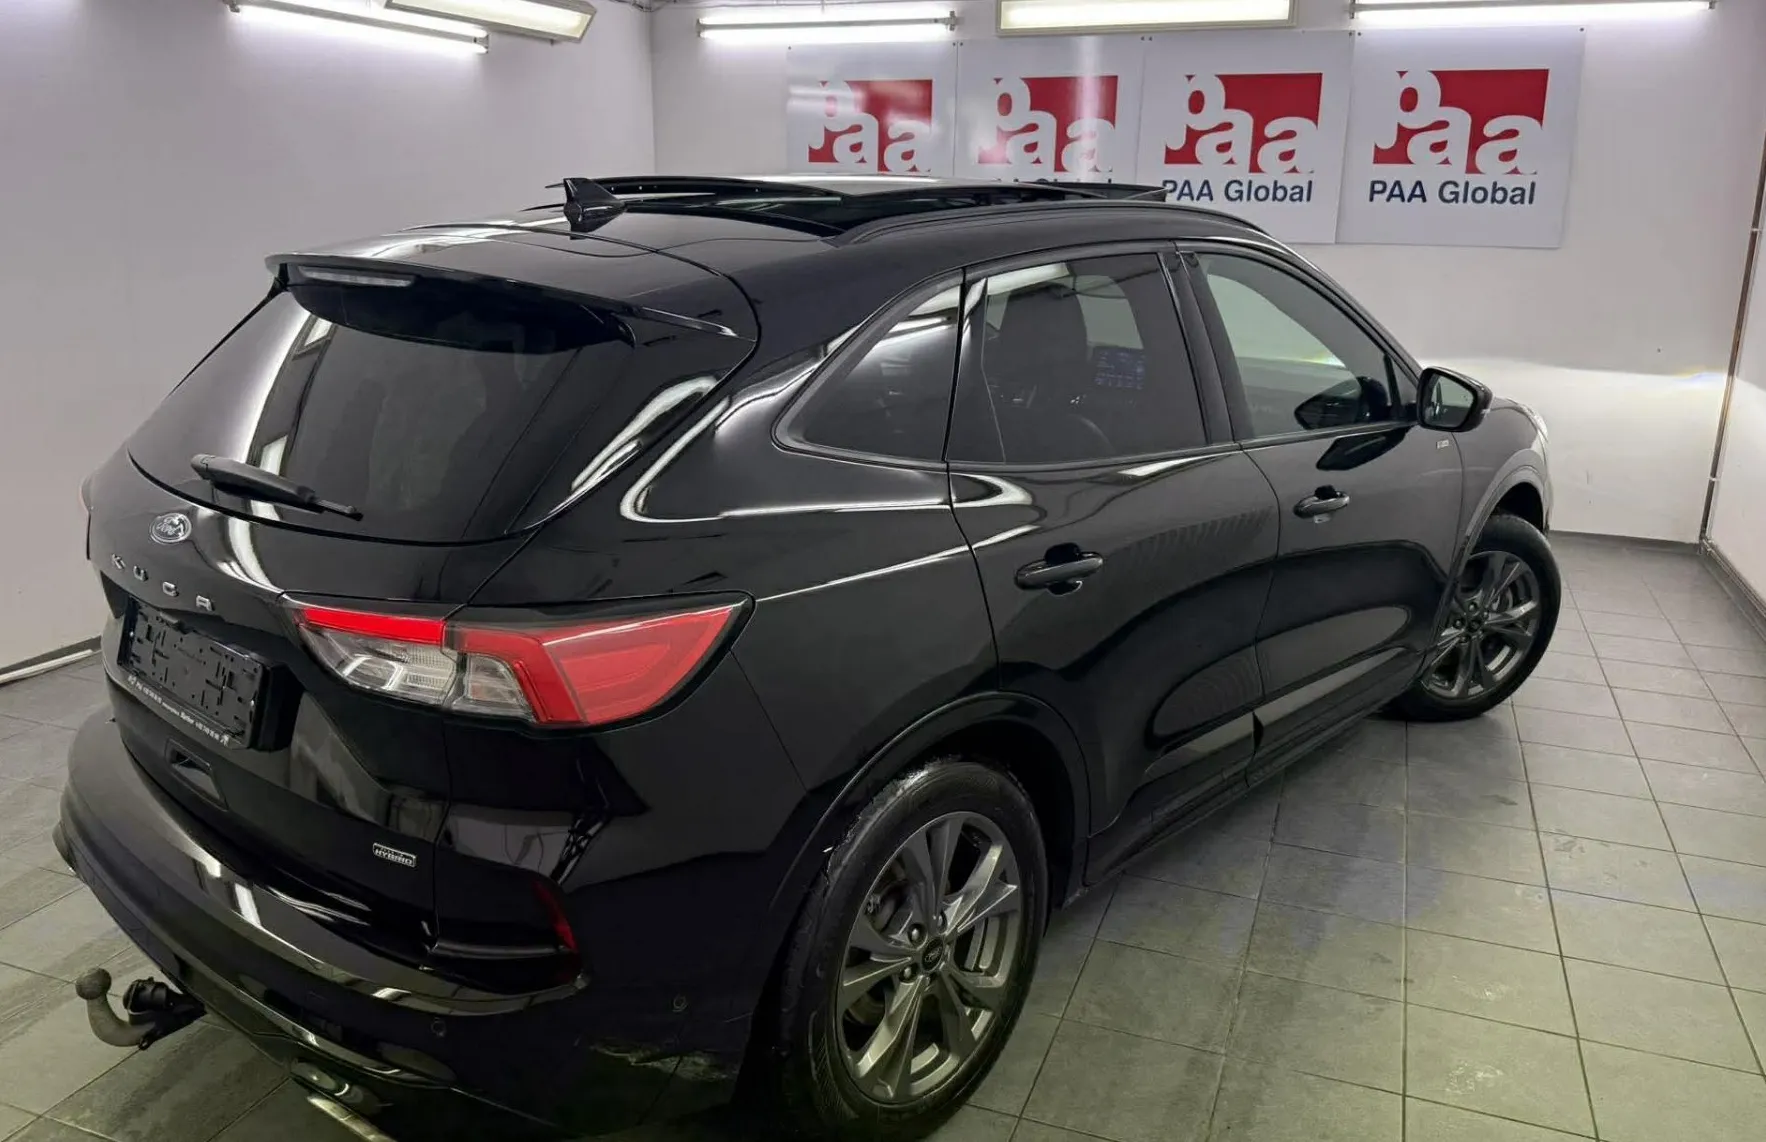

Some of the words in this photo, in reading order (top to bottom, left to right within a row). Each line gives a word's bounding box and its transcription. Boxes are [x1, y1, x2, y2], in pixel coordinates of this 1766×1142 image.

[1165, 73, 1318, 173] paa
[1373, 69, 1544, 175] paa
[1162, 179, 1214, 202] PAA
[1224, 179, 1313, 203] Global
[1369, 180, 1427, 203] PAA
[1438, 180, 1536, 205] Global
[111, 553, 214, 612] KUGA
